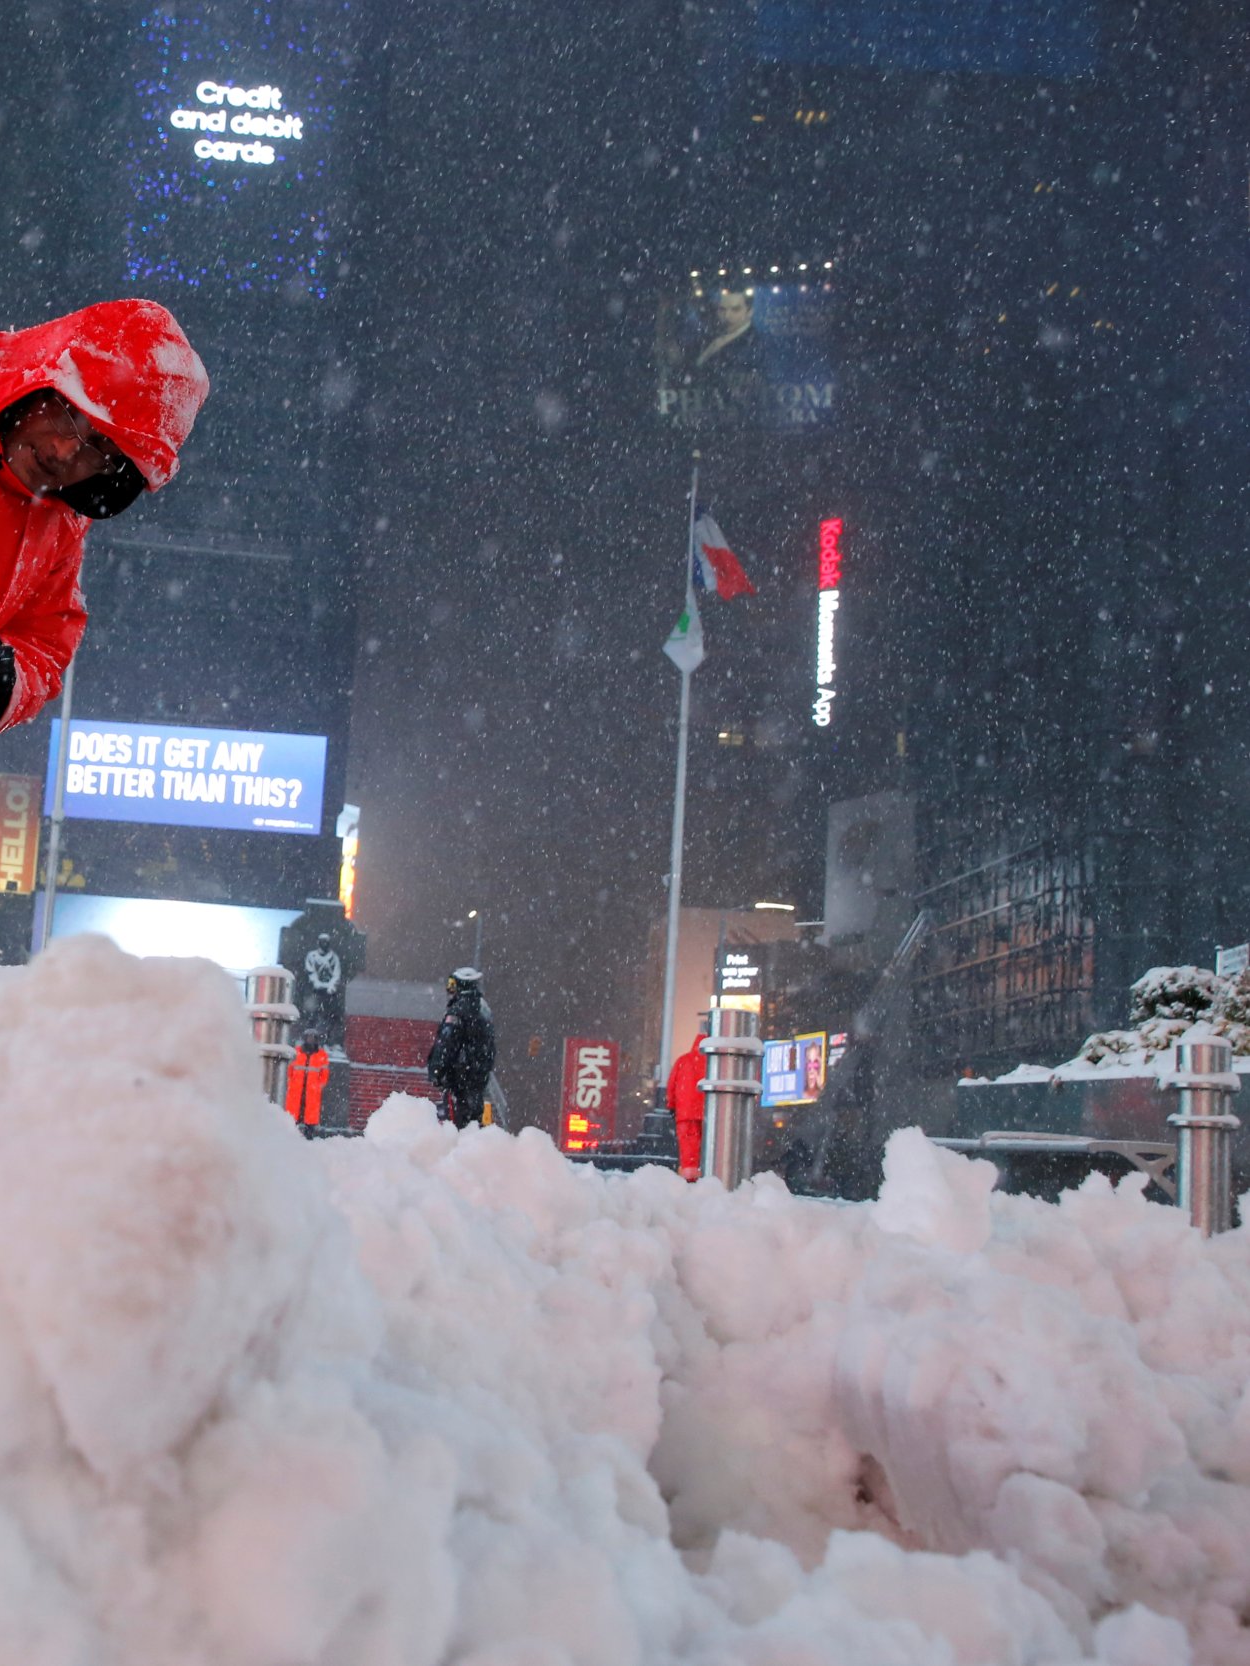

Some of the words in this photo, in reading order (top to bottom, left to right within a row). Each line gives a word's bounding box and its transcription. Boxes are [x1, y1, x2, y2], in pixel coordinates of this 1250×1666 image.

[196, 81, 282, 110] Credit
[170, 109, 227, 133] and
[230, 112, 304, 140] debit
[194, 139, 275, 165] cards
[658, 383, 836, 415] PHAOM
[819, 517, 843, 589] Kodak
[816, 590, 840, 685] Moments
[812, 688, 837, 727] App
[69, 732, 133, 764] DOES
[137, 736, 161, 766] IT
[164, 738, 210, 769] GET
[212, 742, 264, 773] ANY
[66, 764, 155, 798] BETTER
[160, 770, 226, 803] THAN
[231, 774, 302, 808] THIS?
[722, 978, 751, 989] phone
[737, 967, 759, 978] your
[576, 1045, 611, 1109] tkts
